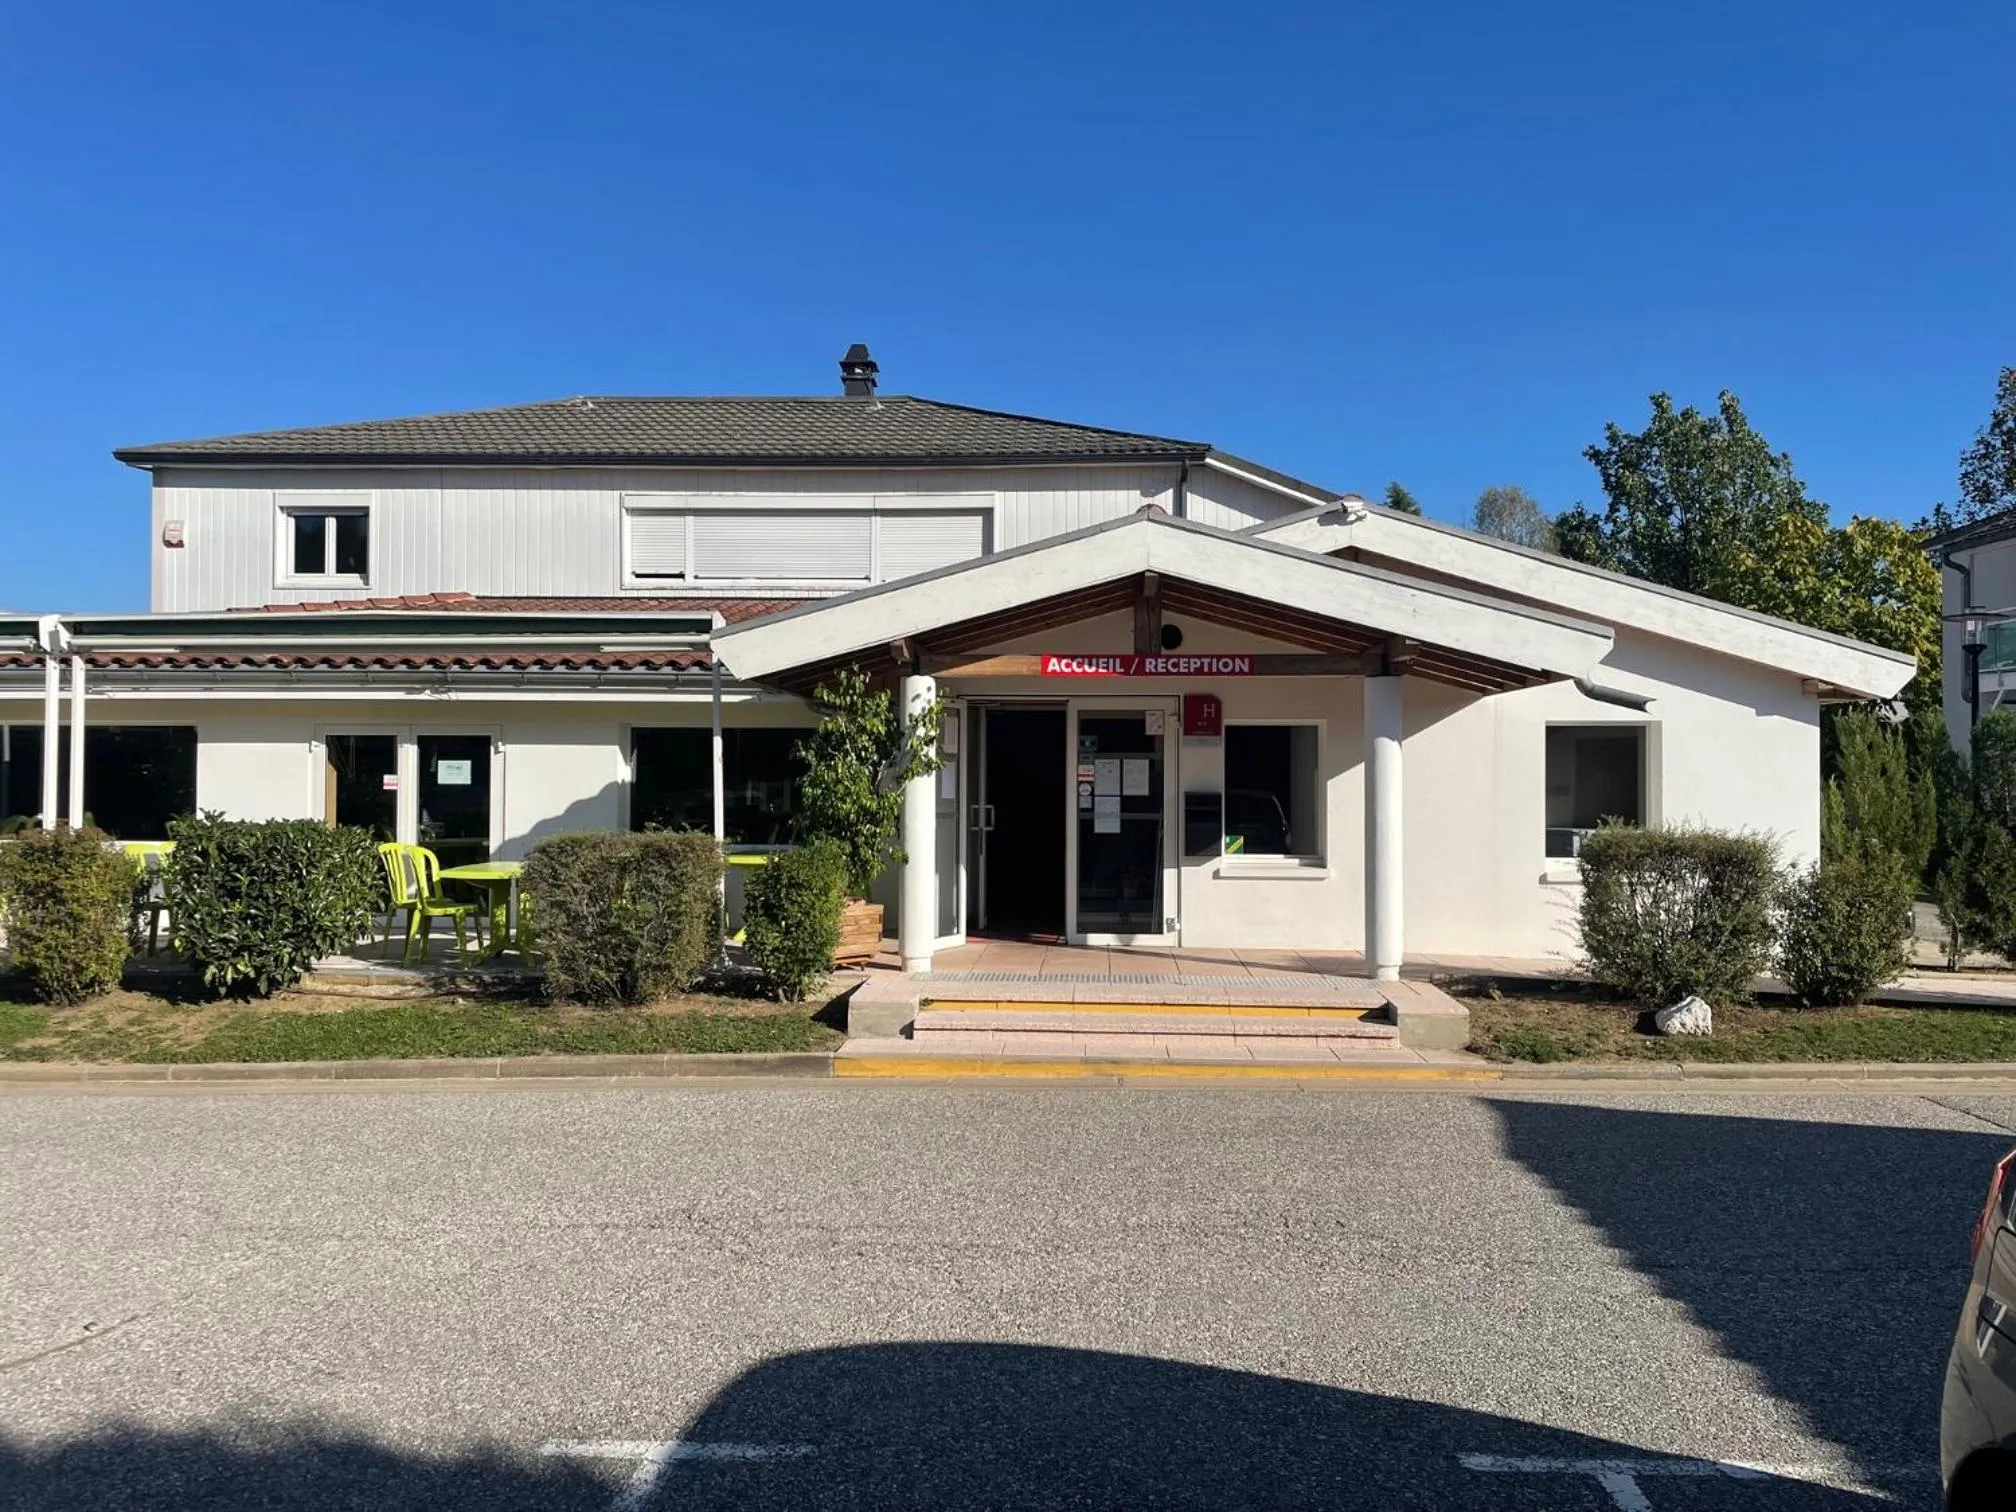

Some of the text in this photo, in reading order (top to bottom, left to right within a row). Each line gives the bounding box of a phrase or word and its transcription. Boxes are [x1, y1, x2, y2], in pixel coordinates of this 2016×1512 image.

[1046, 657, 1250, 674] ACCUEIL / RECEPTION
[1203, 703, 1216, 718] H
